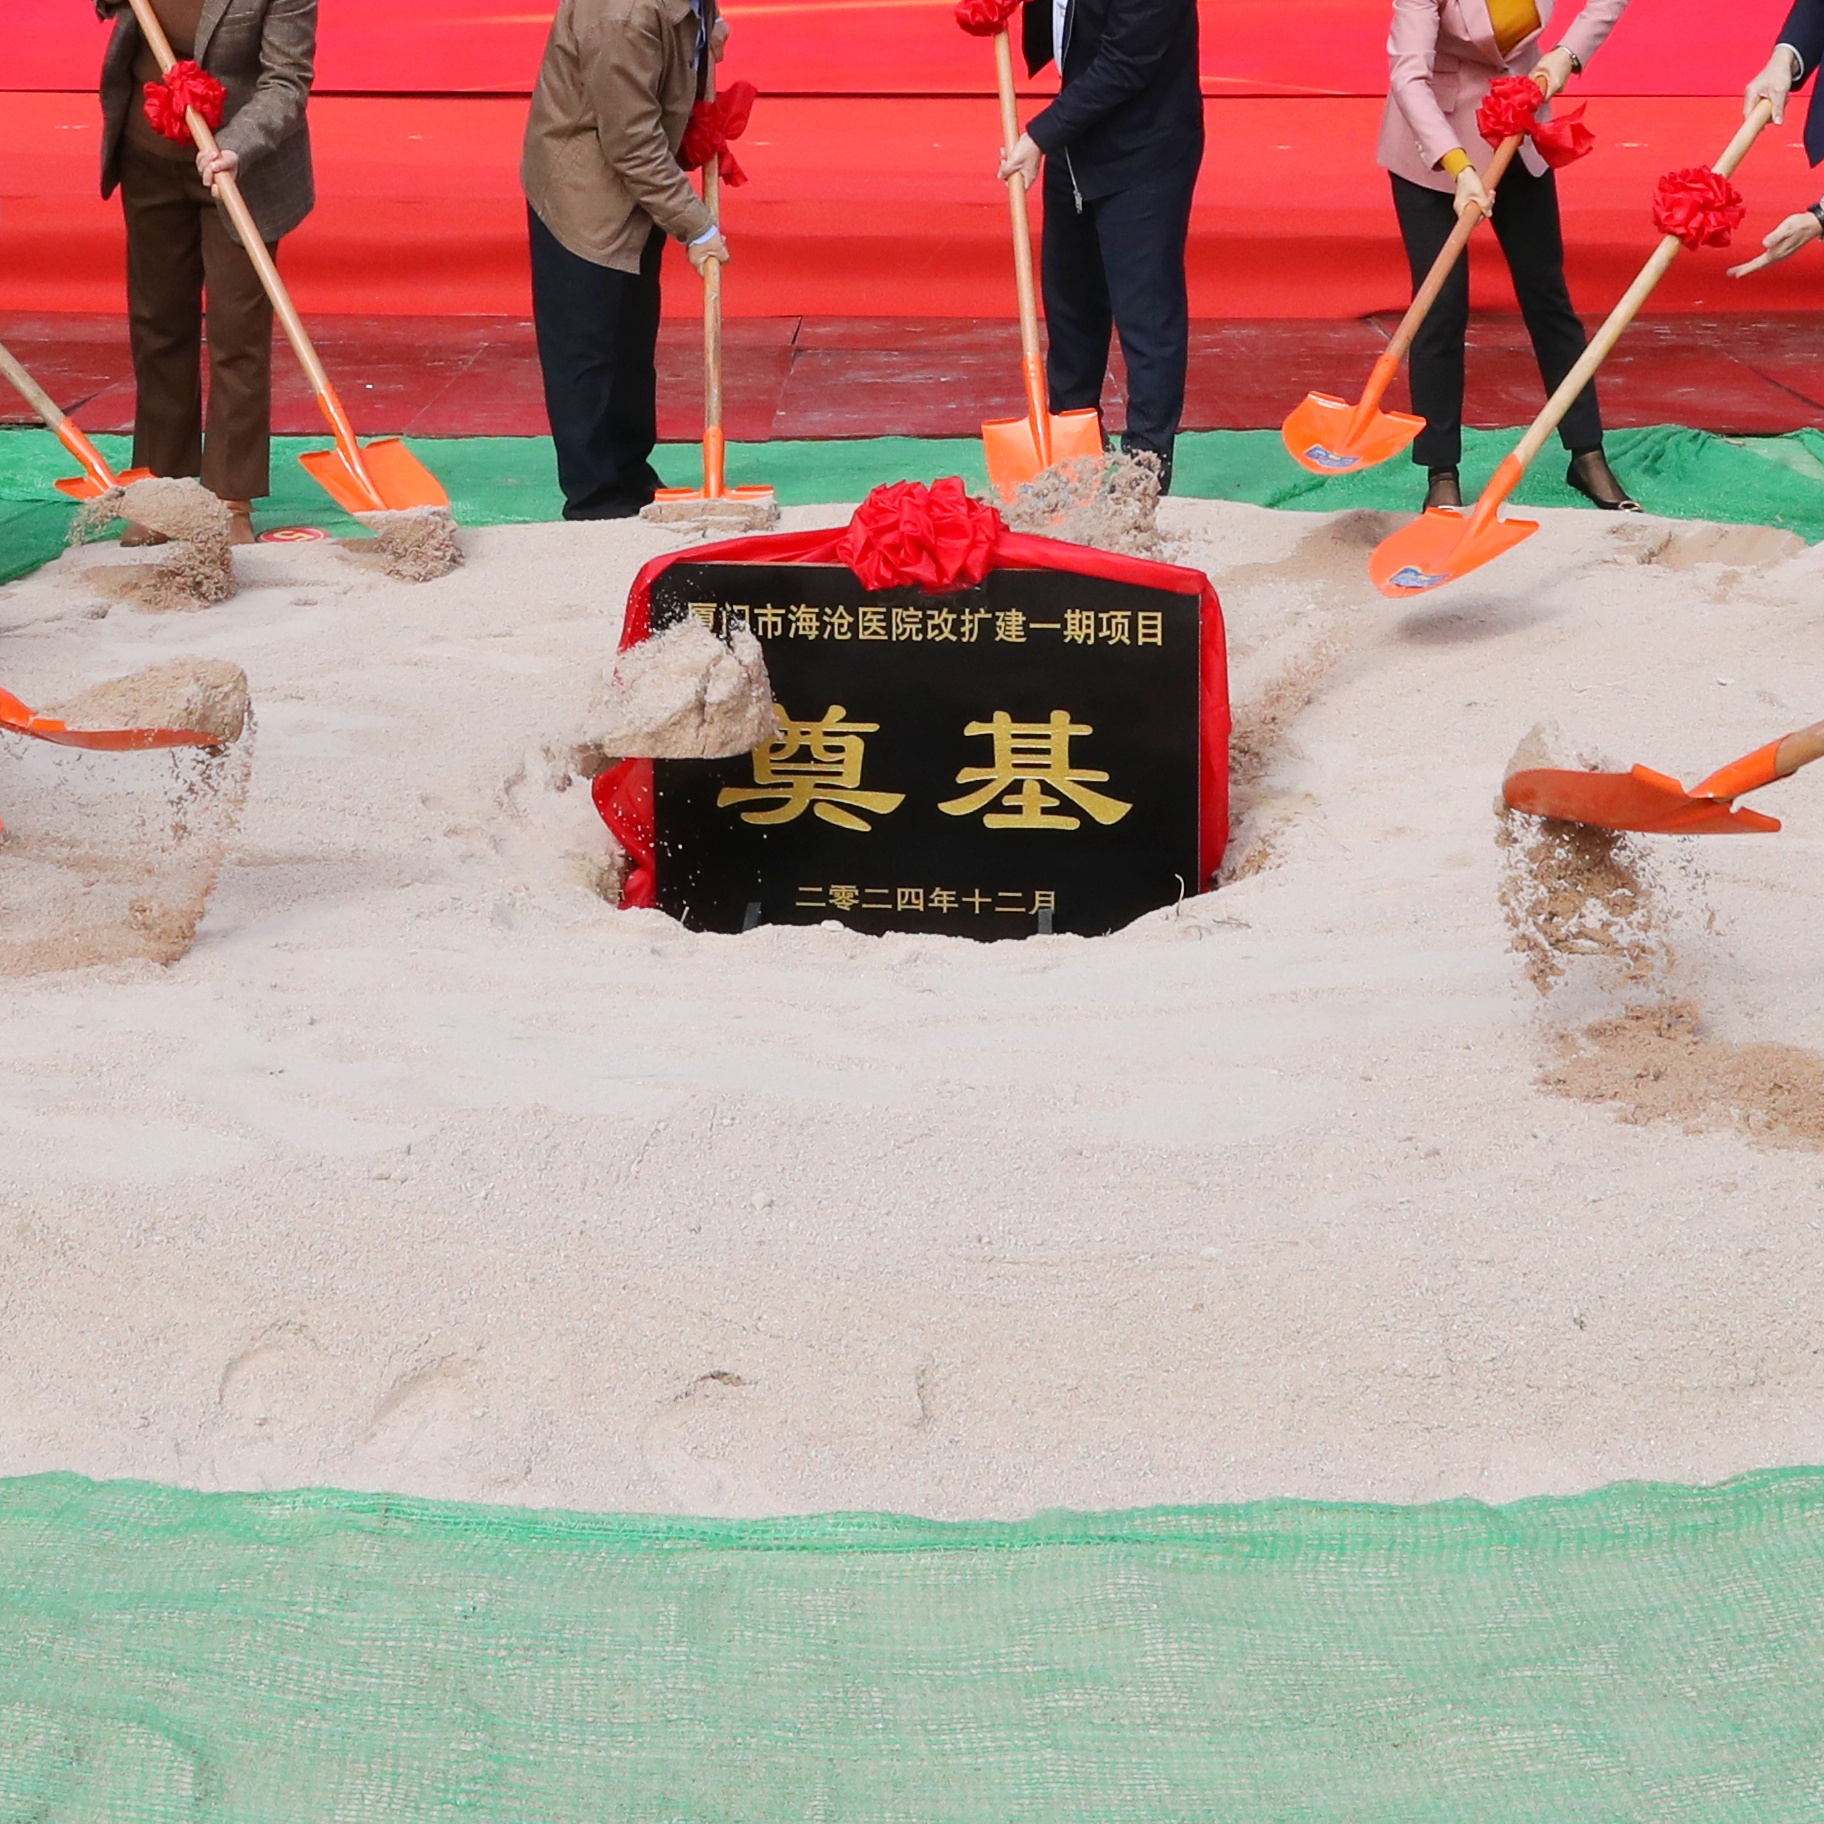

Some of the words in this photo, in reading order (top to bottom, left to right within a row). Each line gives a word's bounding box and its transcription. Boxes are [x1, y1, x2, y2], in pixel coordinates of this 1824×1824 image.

[716, 704, 1134, 832] 奠基
[794, 884, 1057, 915] 二零二四年十二月
